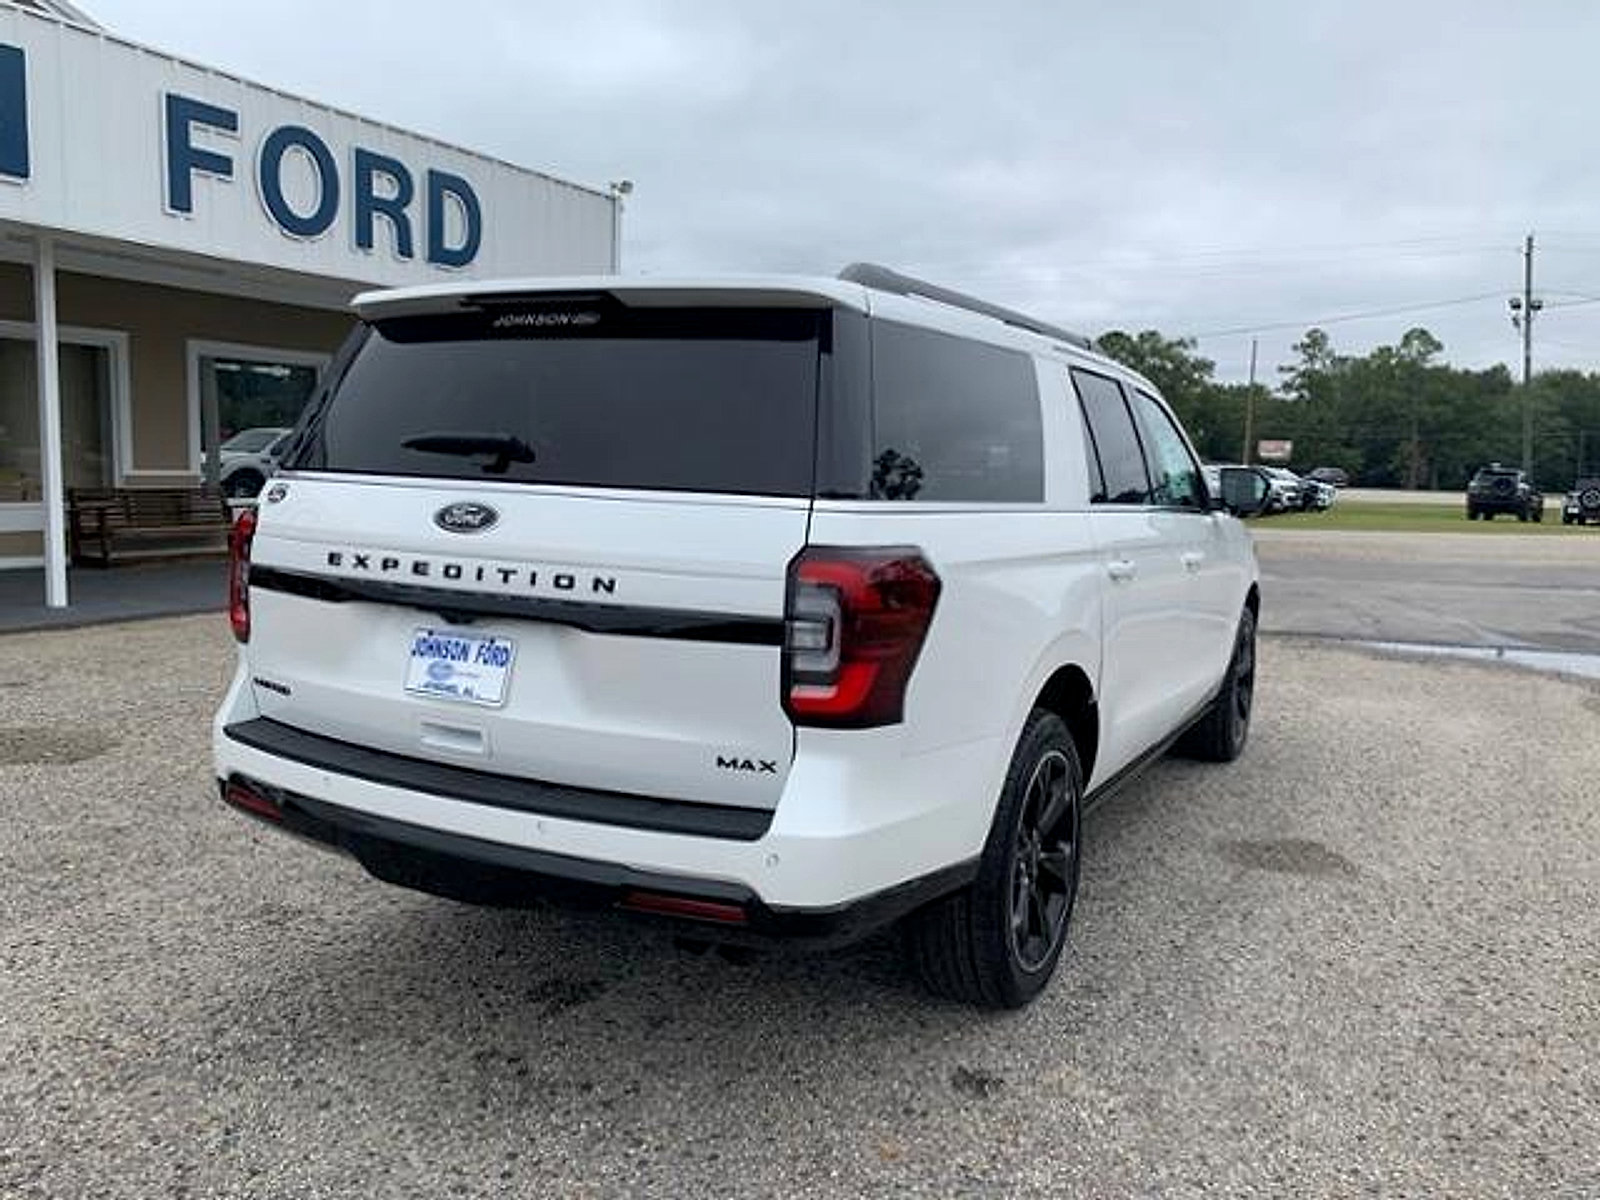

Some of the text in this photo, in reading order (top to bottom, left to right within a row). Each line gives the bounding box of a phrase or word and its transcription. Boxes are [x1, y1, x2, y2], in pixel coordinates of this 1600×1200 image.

[163, 92, 481, 268] FORD
[493, 312, 570, 327] JOHNSON
[327, 551, 617, 594] EXPEDITION
[411, 636, 510, 667] JOHNSON FORD
[717, 755, 777, 773] MAX
